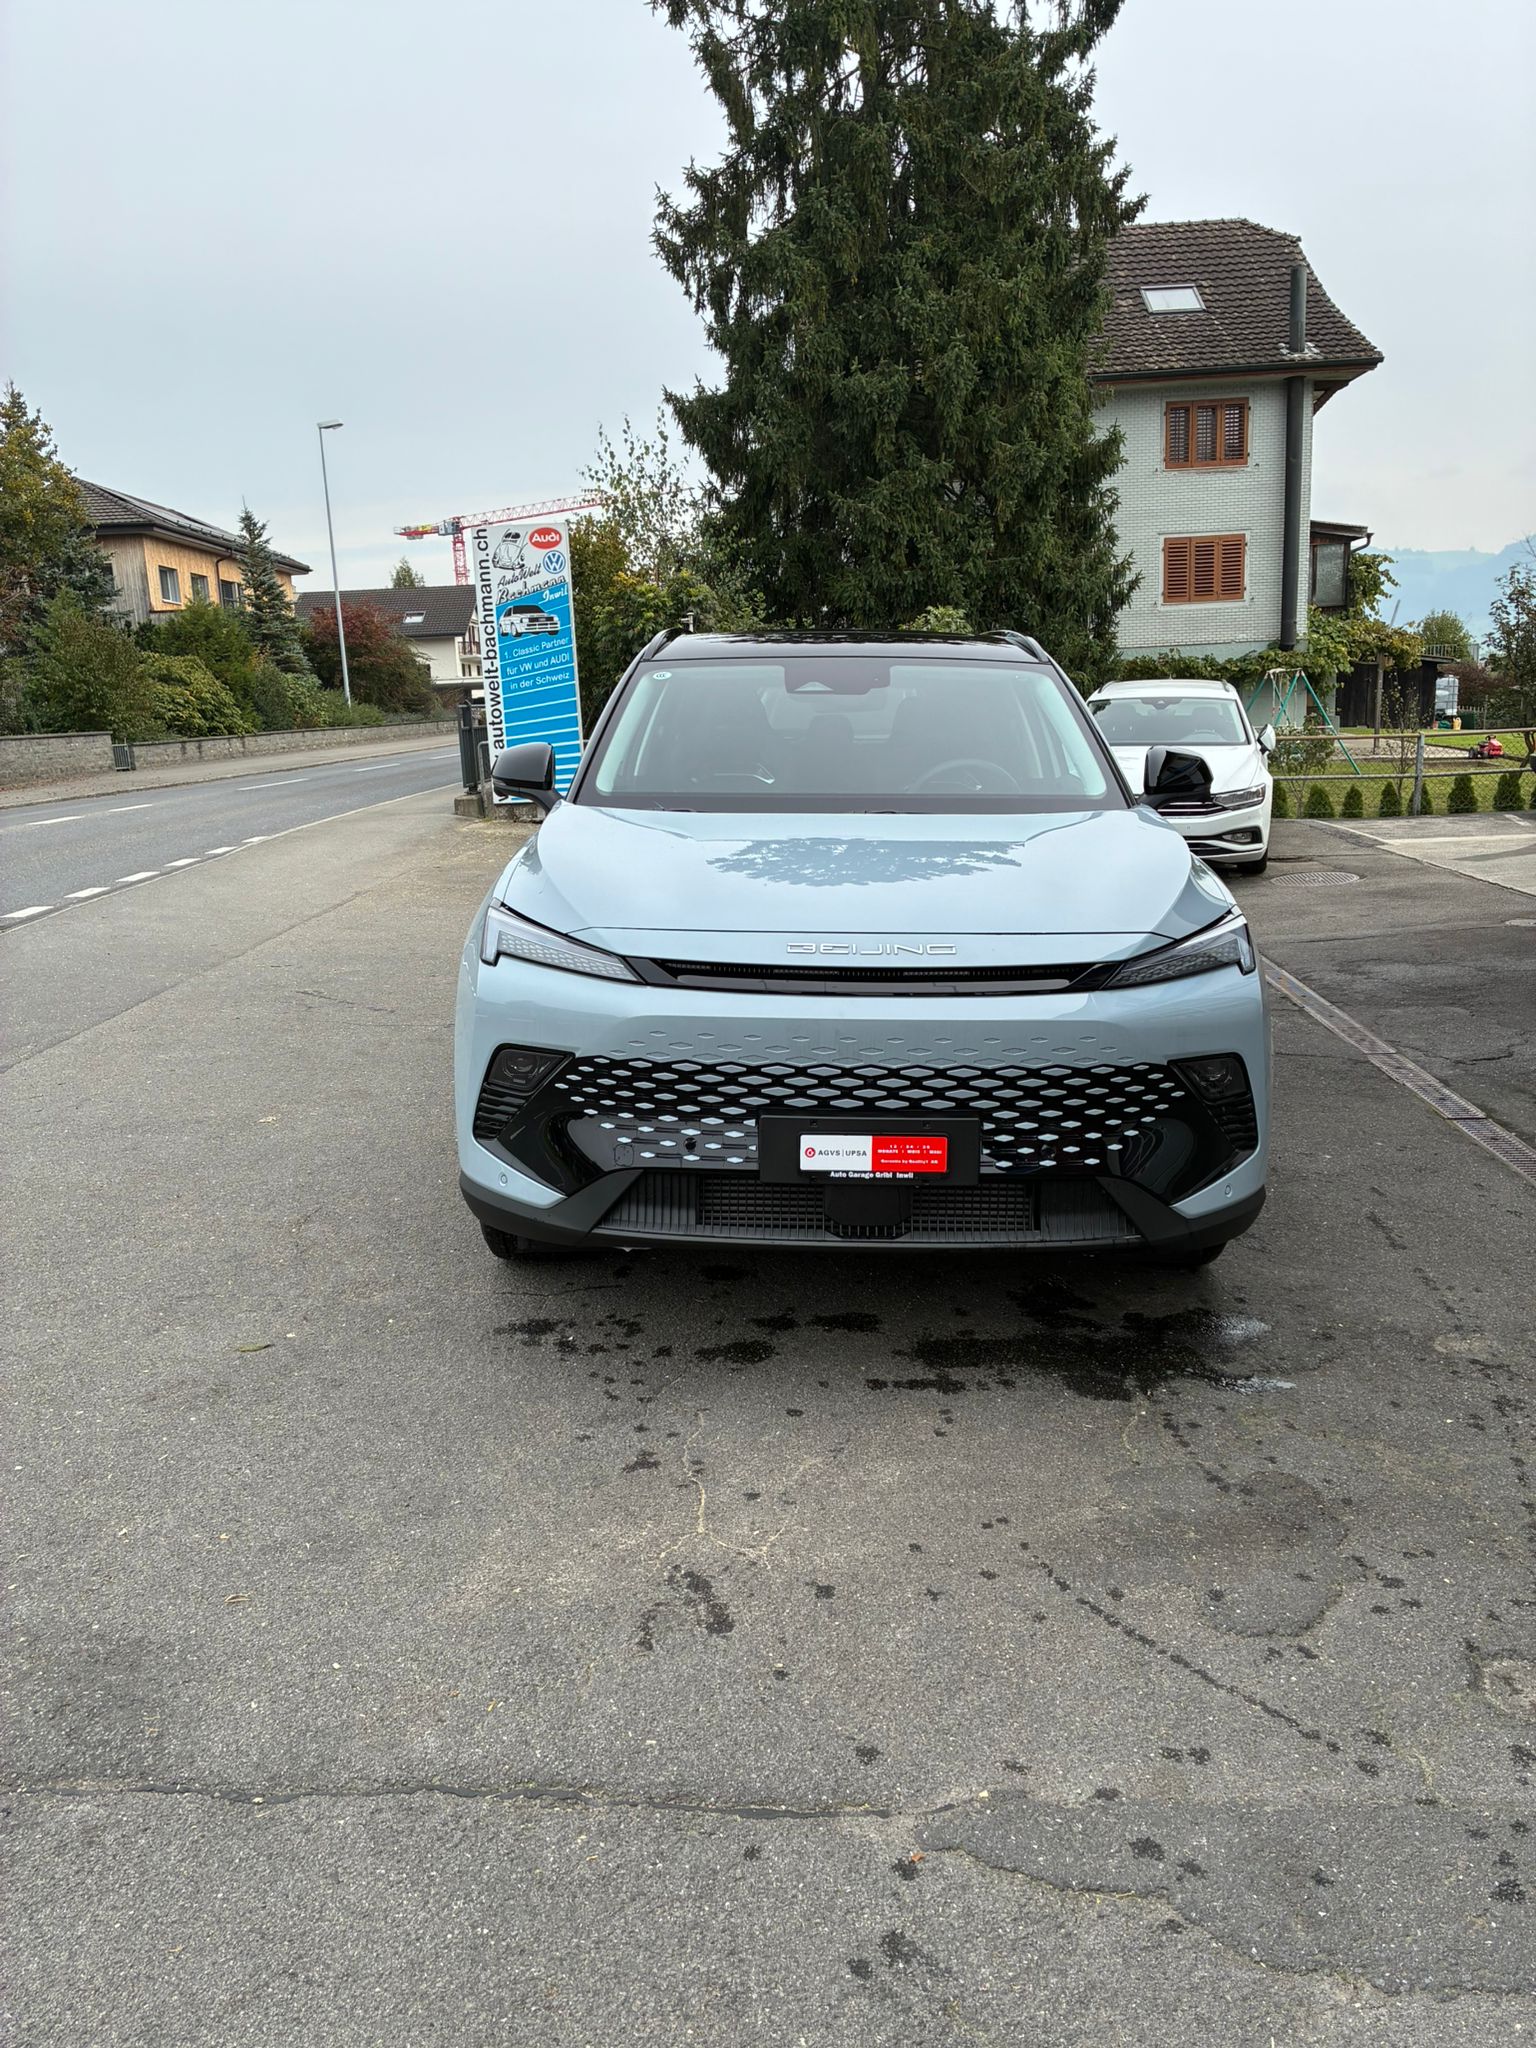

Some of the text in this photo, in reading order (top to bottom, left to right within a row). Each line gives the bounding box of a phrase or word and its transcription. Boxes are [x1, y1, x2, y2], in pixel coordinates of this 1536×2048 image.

[531, 532, 560, 543] Audi
[543, 585, 568, 602] Inwil
[504, 637, 569, 660] 1. Classic Partner
[506, 652, 570, 676] für VW und AUDI
[510, 671, 570, 690] in der Schweiz
[786, 943, 957, 955] BEIJING
[818, 1149, 868, 1157] AGVS UPSA
[848, 1171, 874, 1179] Garage
